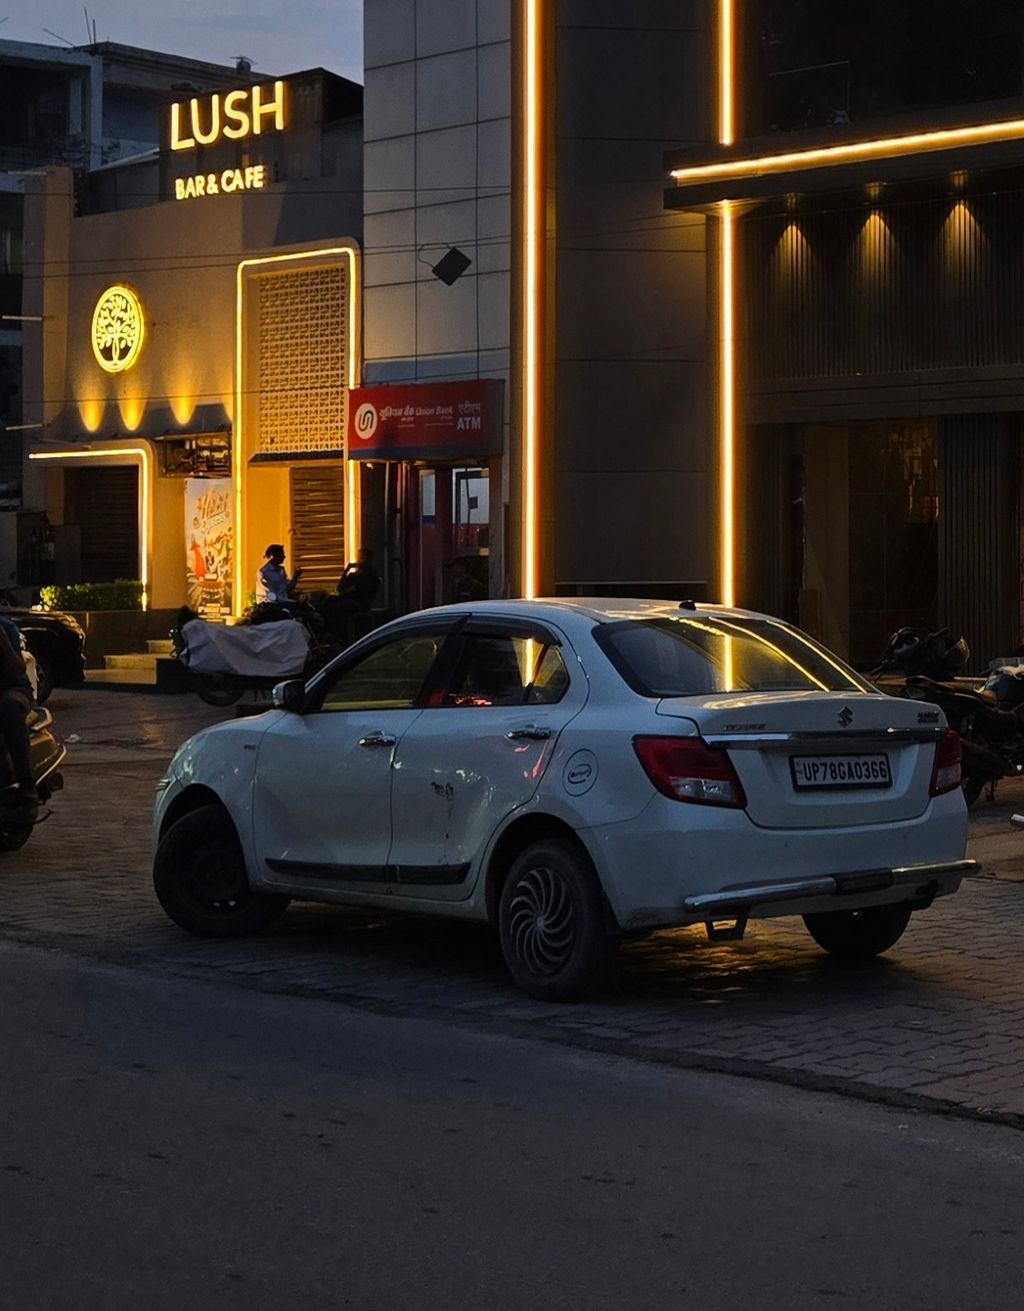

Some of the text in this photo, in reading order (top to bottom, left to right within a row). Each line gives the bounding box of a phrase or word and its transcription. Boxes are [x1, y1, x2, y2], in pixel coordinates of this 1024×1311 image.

[170, 81, 286, 151] LUSH
[175, 175, 206, 200] BAR
[220, 165, 264, 193] CAFE
[415, 406, 453, 417] Union Bank
[457, 417, 481, 431] ATM
[802, 760, 888, 782] UP78GA0366
